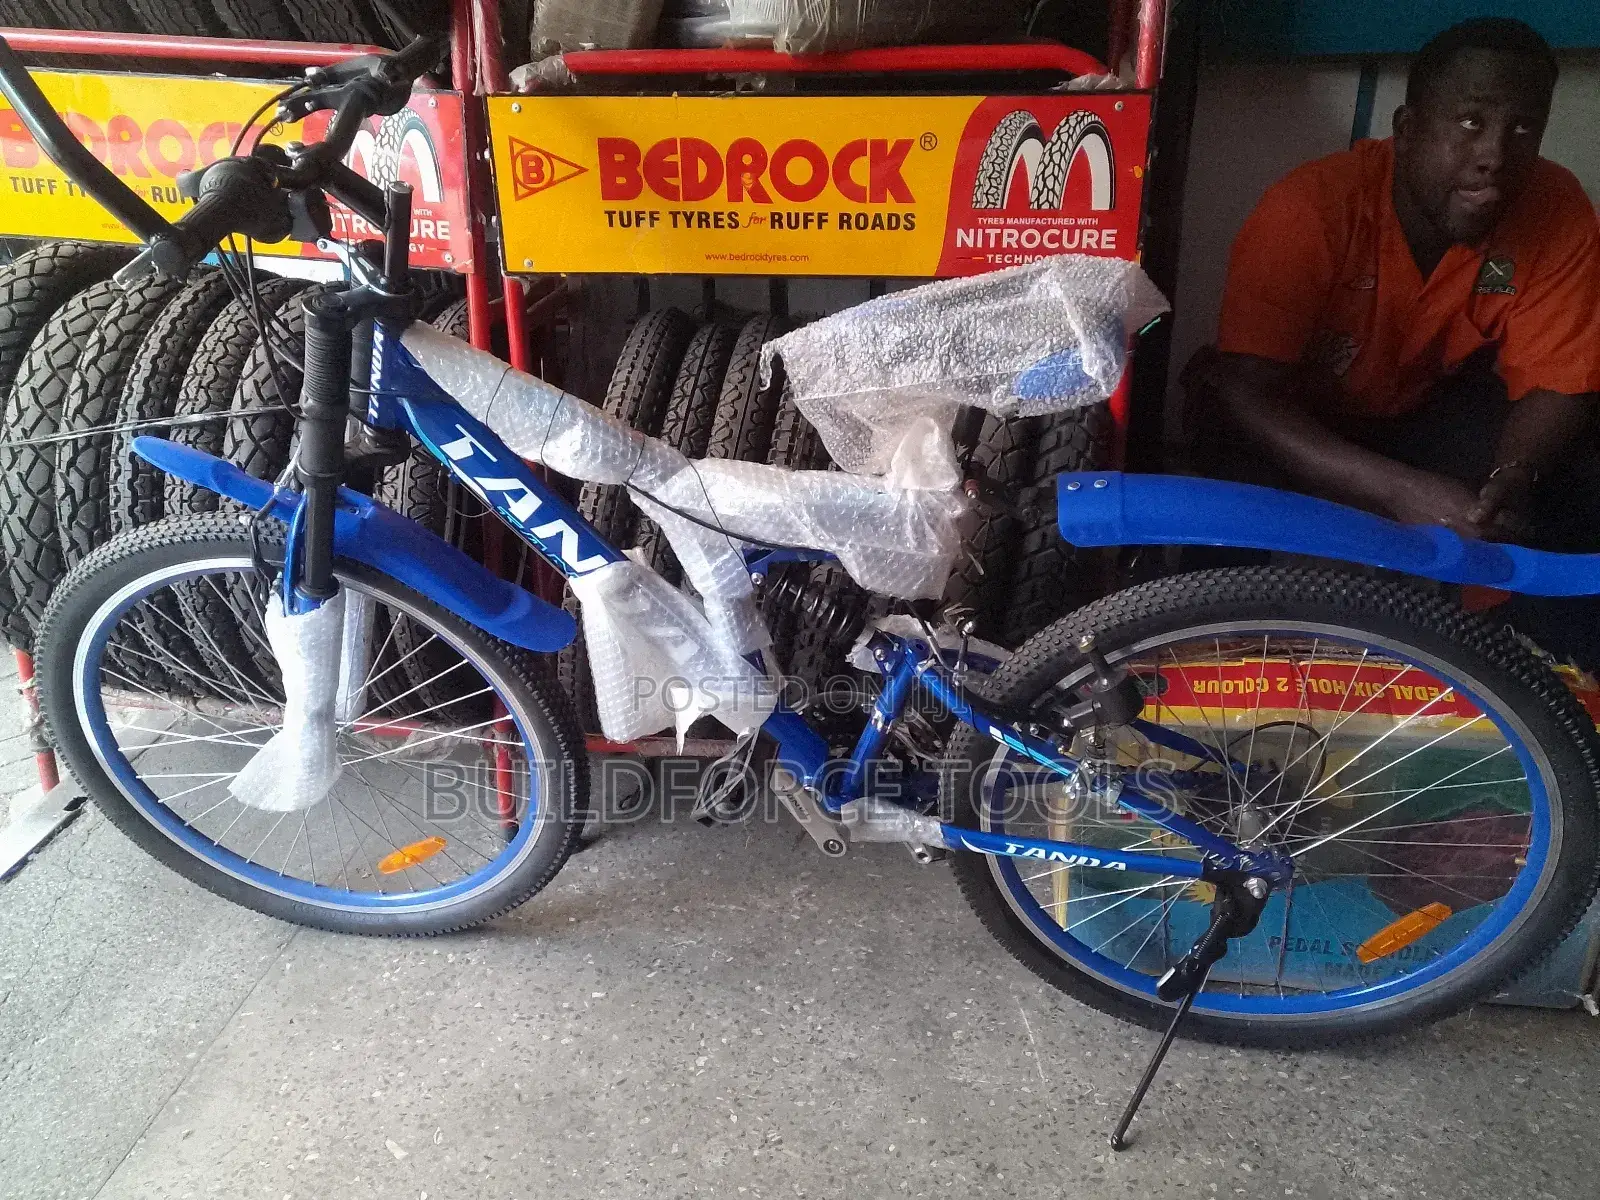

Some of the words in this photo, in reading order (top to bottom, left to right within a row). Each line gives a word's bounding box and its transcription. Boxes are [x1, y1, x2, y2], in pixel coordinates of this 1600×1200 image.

[597, 137, 917, 204] BEDROCK
[9, 176, 58, 194] TUFF
[413, 208, 433, 216] WITH
[604, 210, 661, 229] TUFF
[669, 210, 740, 230] TYRES
[742, 211, 767, 229] for
[769, 211, 829, 230] RUFF
[838, 212, 917, 231] ROADS
[977, 217, 1005, 226] TYRES
[1006, 217, 1076, 226] MANUFACTURED
[1077, 217, 1099, 226] WITH
[956, 227, 1118, 250] NITROCURE
[1192, 676, 1271, 695] COLOUR
[1276, 676, 1290, 693] 2
[1296, 677, 1352, 696] HOLE
[1353, 681, 1384, 699] SIX
[1389, 683, 1457, 704] PEDAL
[1005, 842, 1127, 872] TANDA
[1269, 936, 1335, 957] PEDAL
